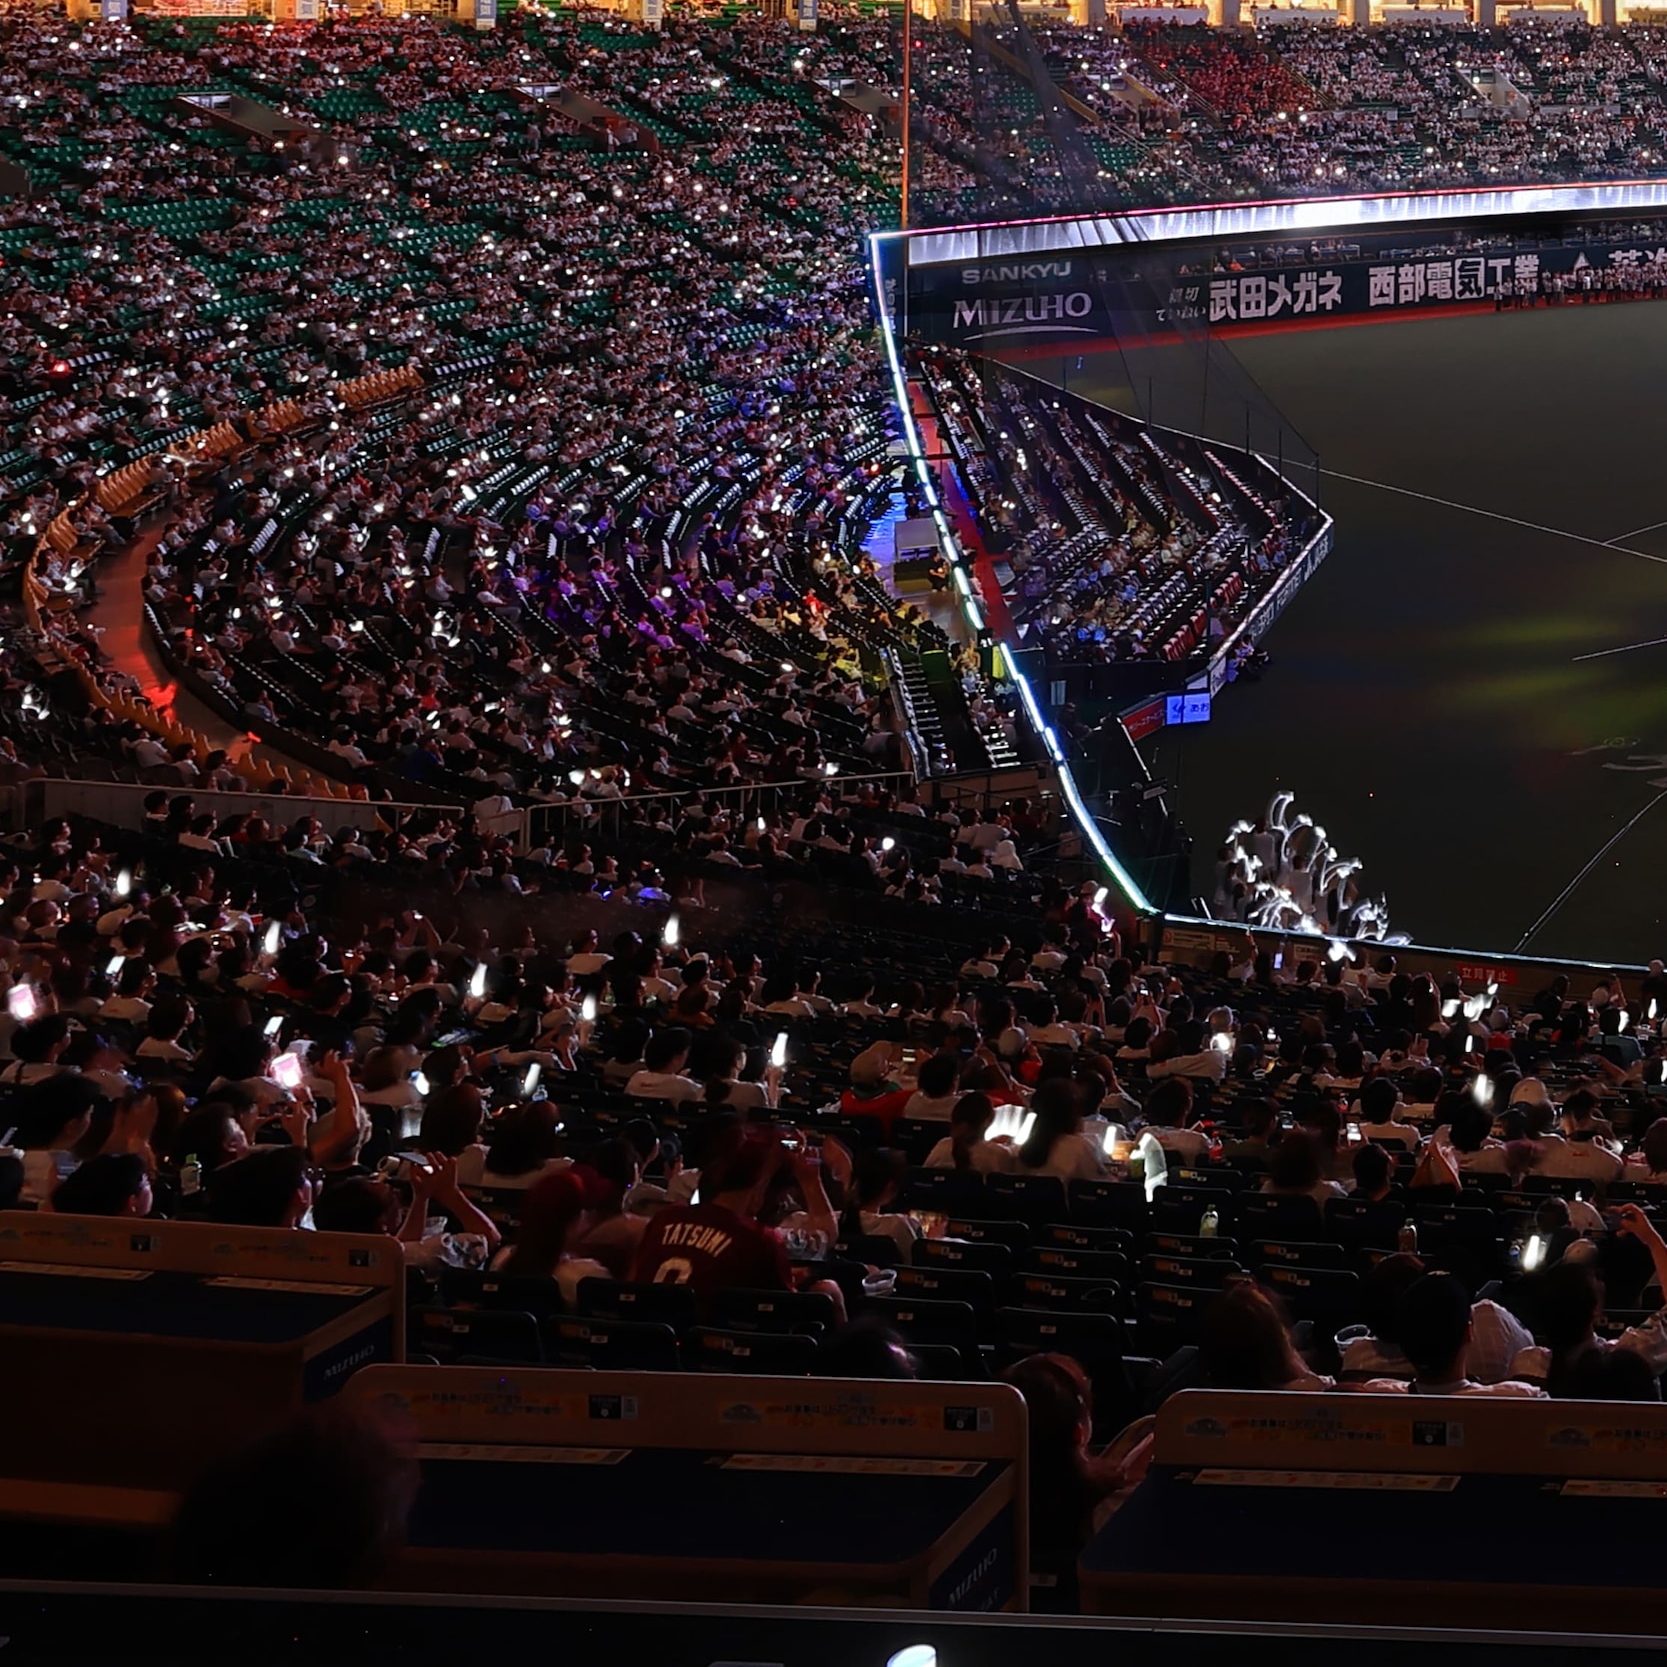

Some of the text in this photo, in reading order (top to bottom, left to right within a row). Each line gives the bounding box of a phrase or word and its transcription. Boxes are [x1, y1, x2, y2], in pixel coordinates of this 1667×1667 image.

[962, 262, 1071, 284] SANKYU
[1369, 254, 1539, 306] 西部電気工業
[953, 292, 1092, 329] MIZUHO
[1209, 271, 1342, 321] 武田メガネ
[662, 1222, 732, 1257] TATSUMI
